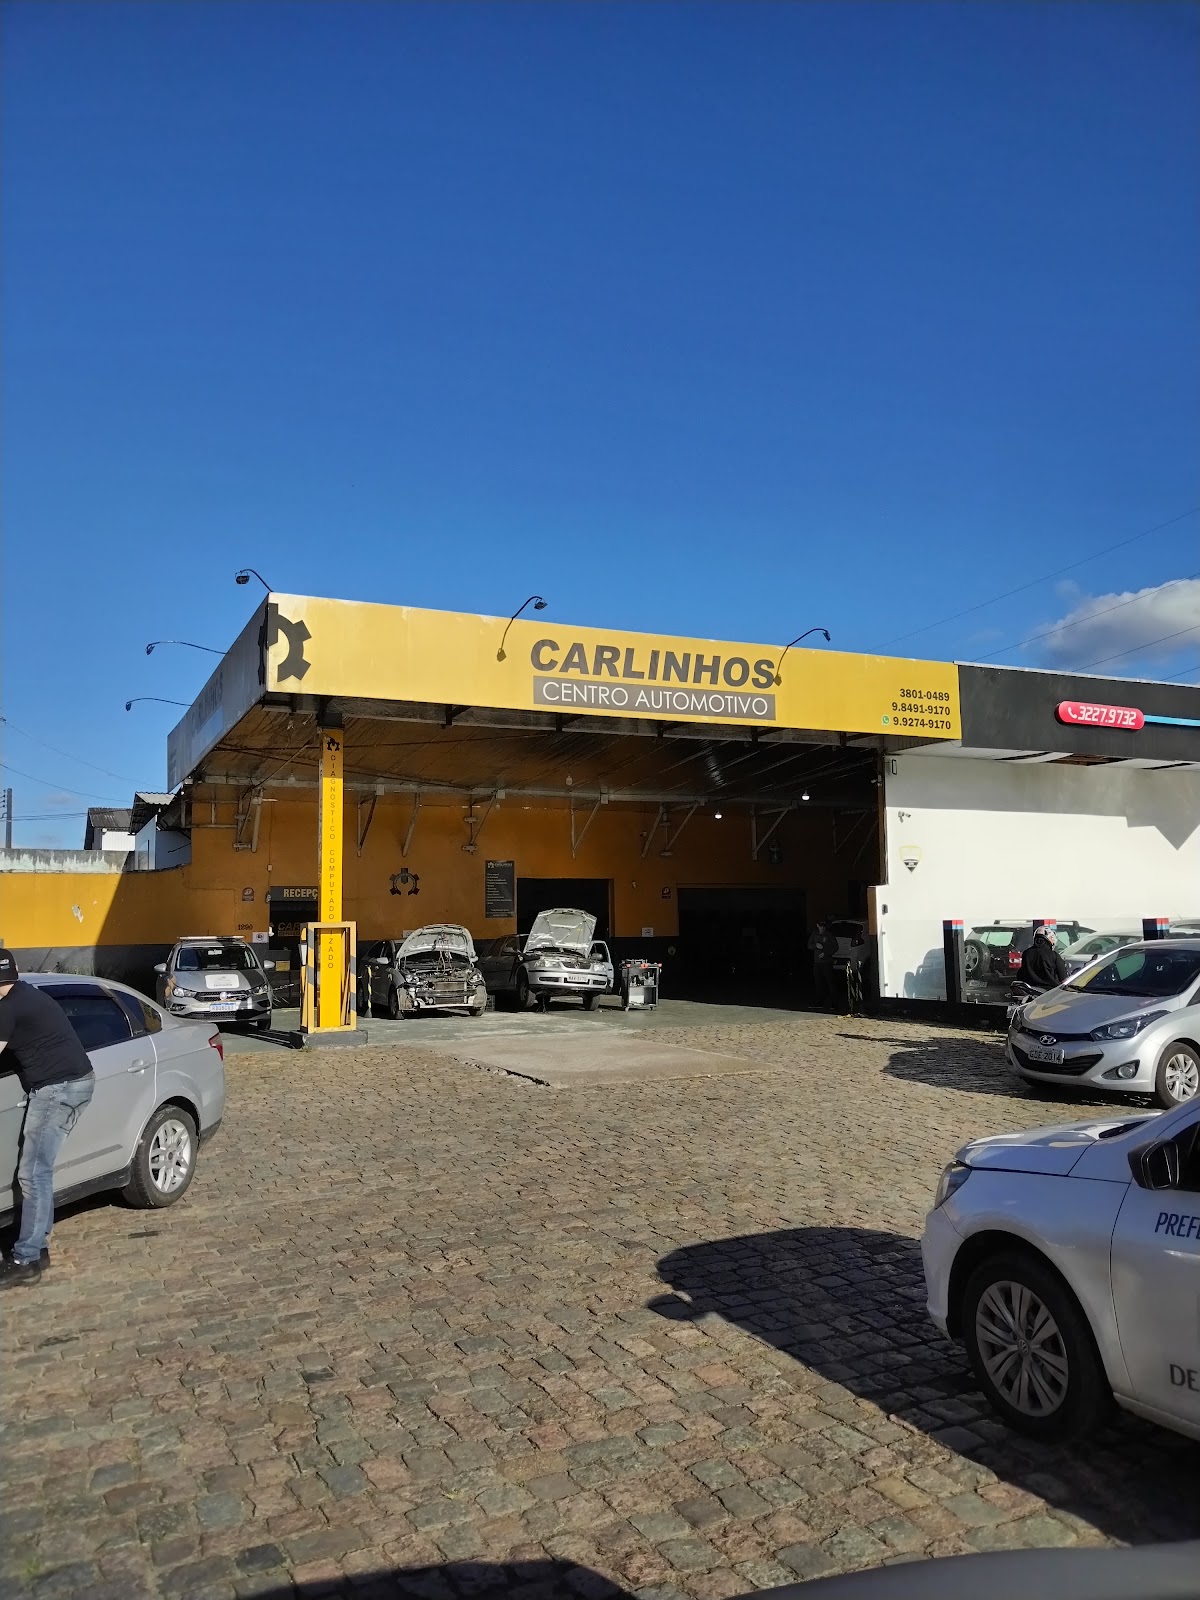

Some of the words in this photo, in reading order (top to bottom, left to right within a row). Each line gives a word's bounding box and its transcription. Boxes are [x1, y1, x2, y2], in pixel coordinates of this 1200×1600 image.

[531, 639, 775, 689] CARLINHOS
[543, 682, 628, 706] CENTRO
[635, 690, 768, 715] AUTOMOTIVO
[900, 689, 950, 701] 3801-0489
[892, 702, 951, 715] 9.8491-9170
[1078, 706, 1137, 725] 3227.9732
[893, 717, 951, 729] 9.9274-9170
